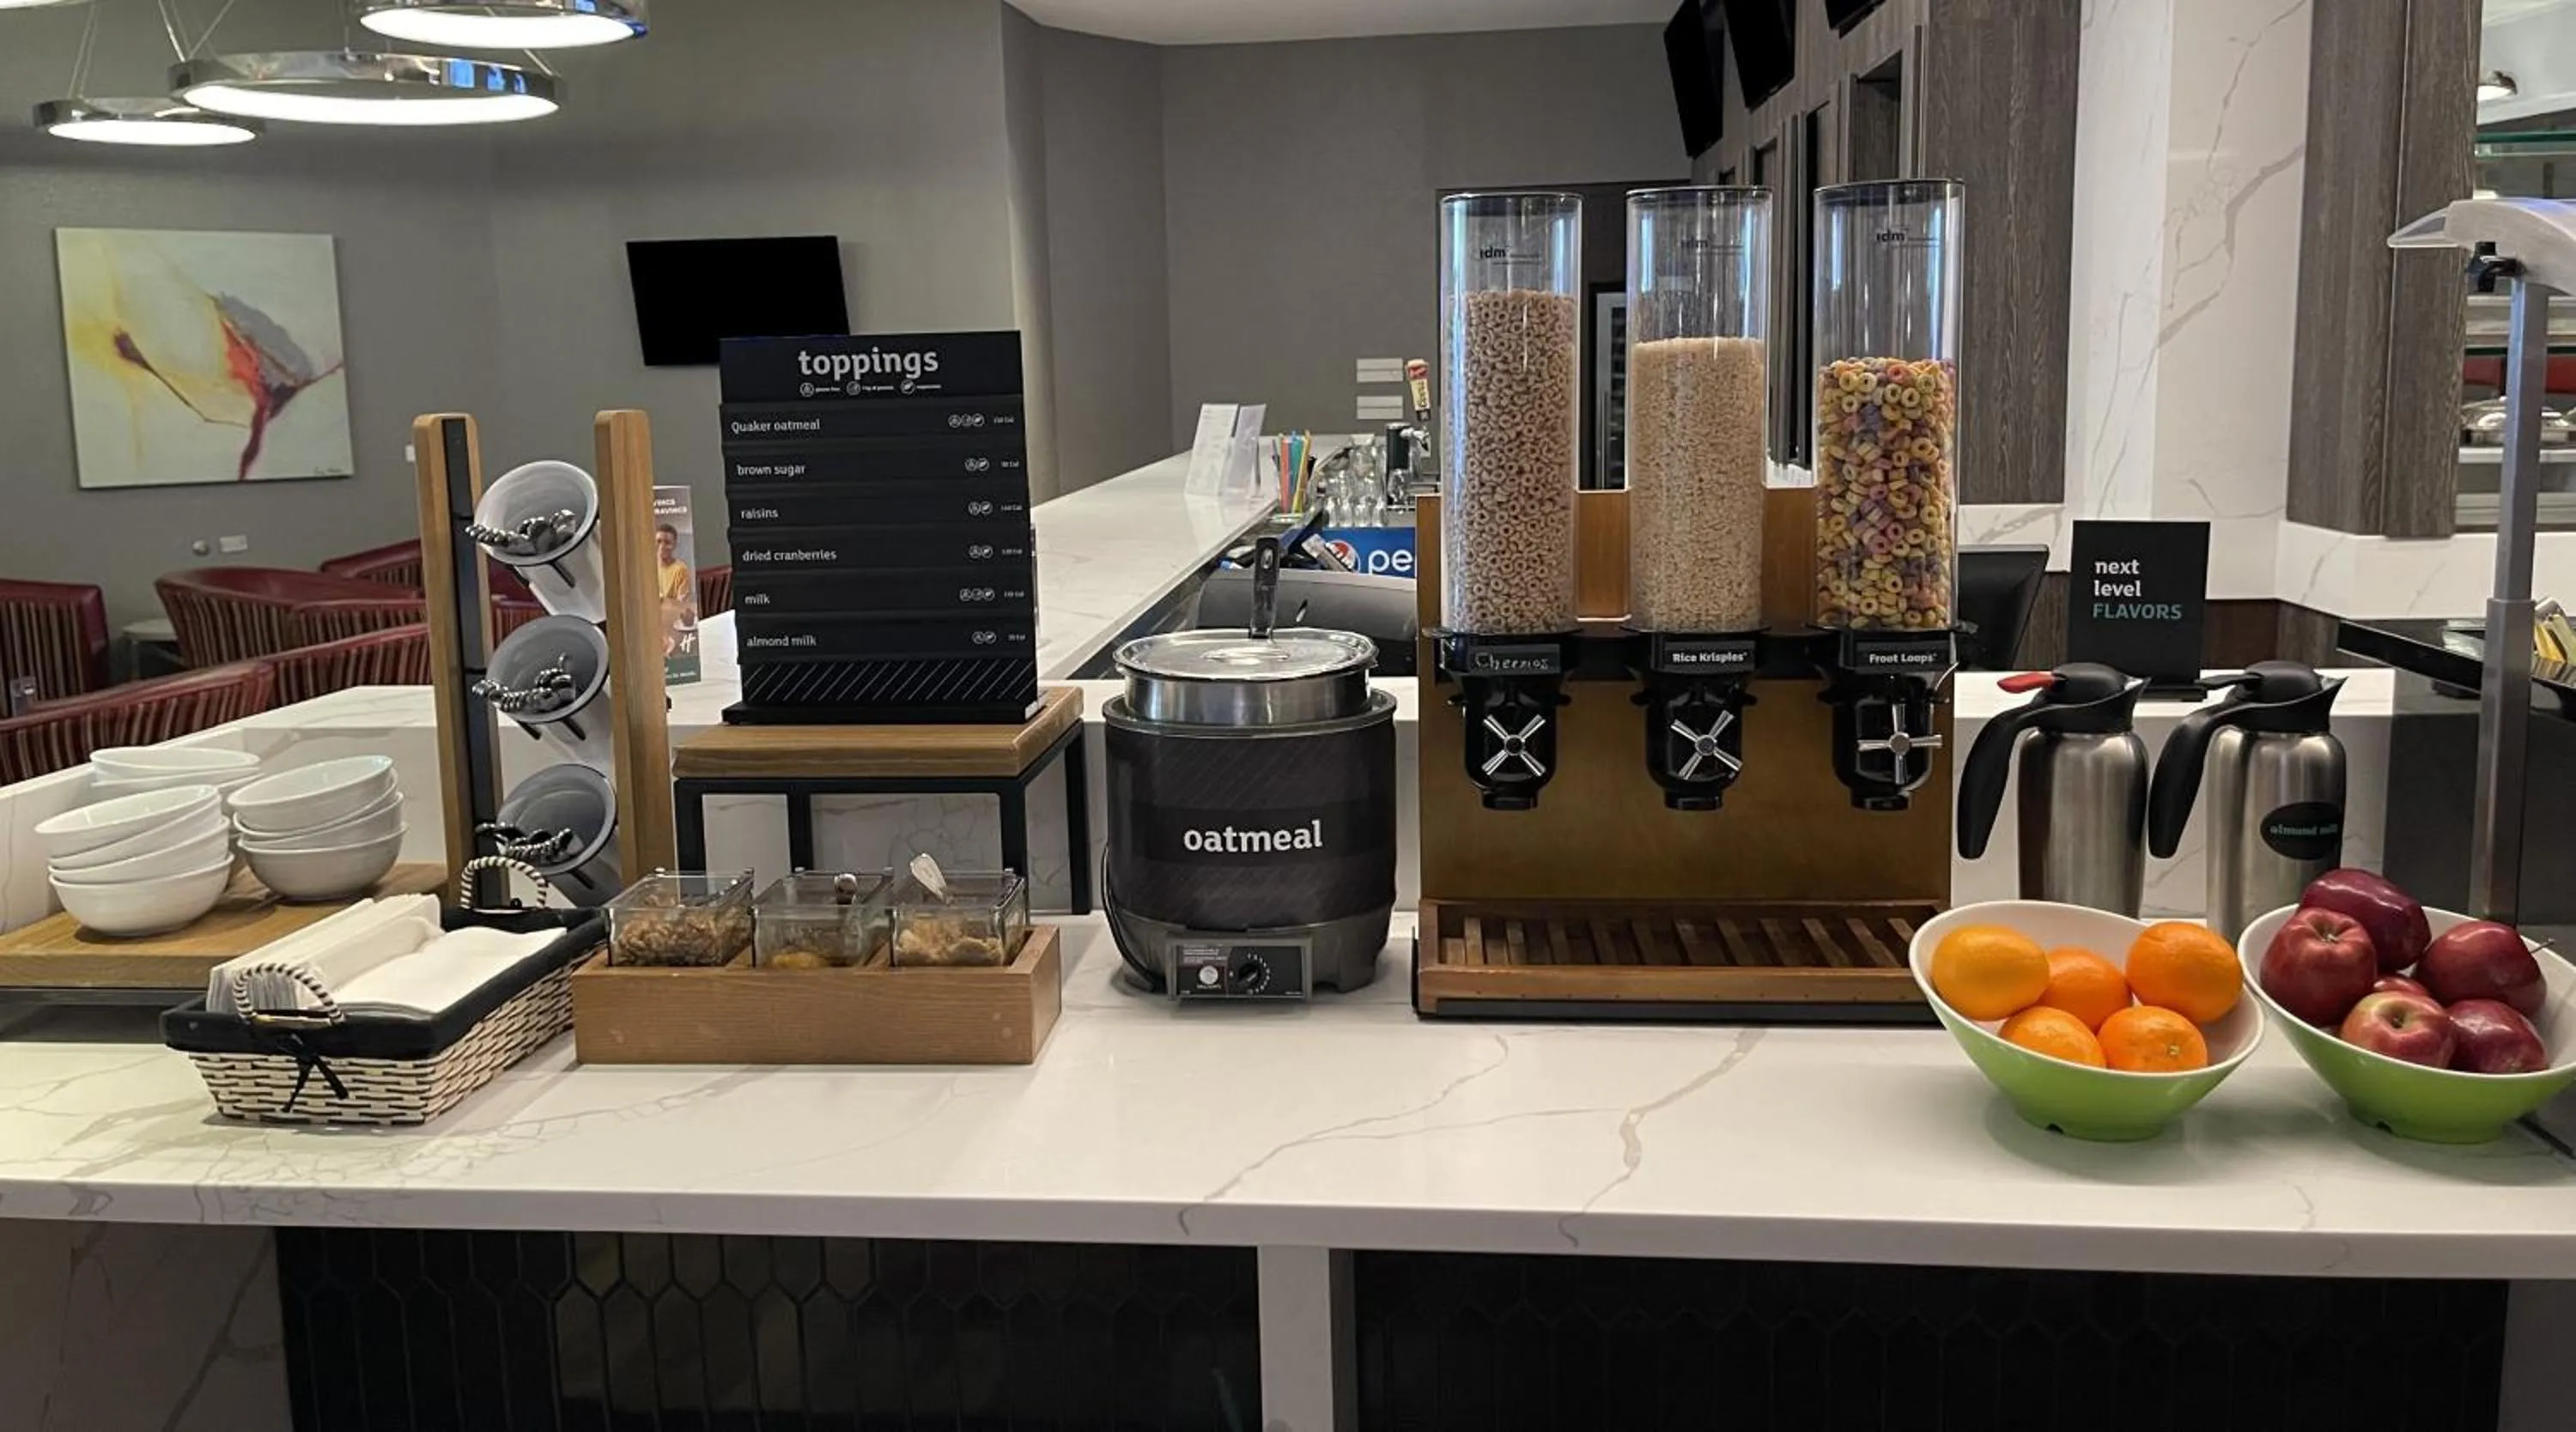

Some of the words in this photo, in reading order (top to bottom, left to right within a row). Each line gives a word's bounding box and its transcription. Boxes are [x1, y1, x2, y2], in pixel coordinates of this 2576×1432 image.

[798, 346, 939, 381] toppings
[732, 420, 771, 434] Quaker
[774, 418, 820, 431] oatmeal
[736, 464, 772, 476] brown
[774, 464, 805, 477] sugar
[741, 507, 779, 519] raisins
[742, 550, 771, 561] dried
[774, 549, 837, 561] cranberries
[2094, 559, 2140, 574] next
[2093, 579, 2142, 597] level
[744, 593, 770, 605] milk
[2093, 603, 2183, 620] FLAVORS
[746, 635, 789, 646] almond
[791, 634, 817, 646] milk
[1672, 652, 1698, 663] Rice
[1869, 653, 1899, 664] Froot
[1183, 819, 1323, 853] oatmeal
